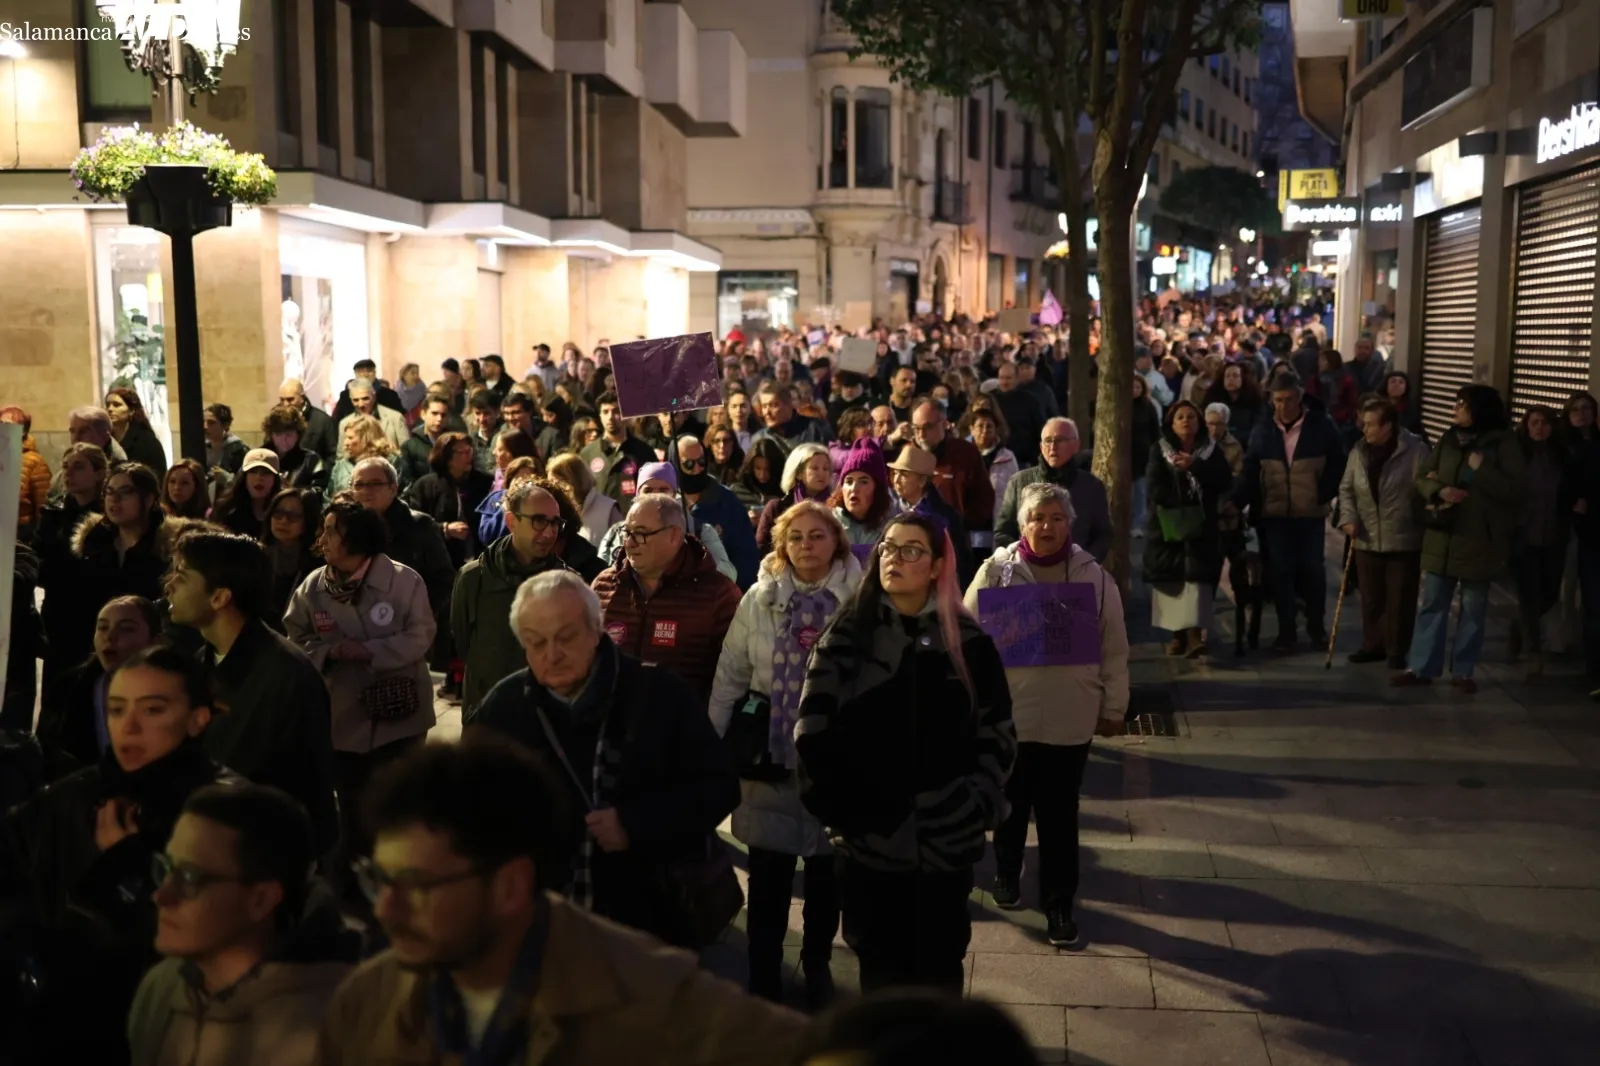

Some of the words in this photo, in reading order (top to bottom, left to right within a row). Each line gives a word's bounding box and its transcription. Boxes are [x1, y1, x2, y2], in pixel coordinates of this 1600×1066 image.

[1286, 204, 1356, 223] Bershka
[655, 622, 663, 630] NO
[668, 623, 675, 631] LA
